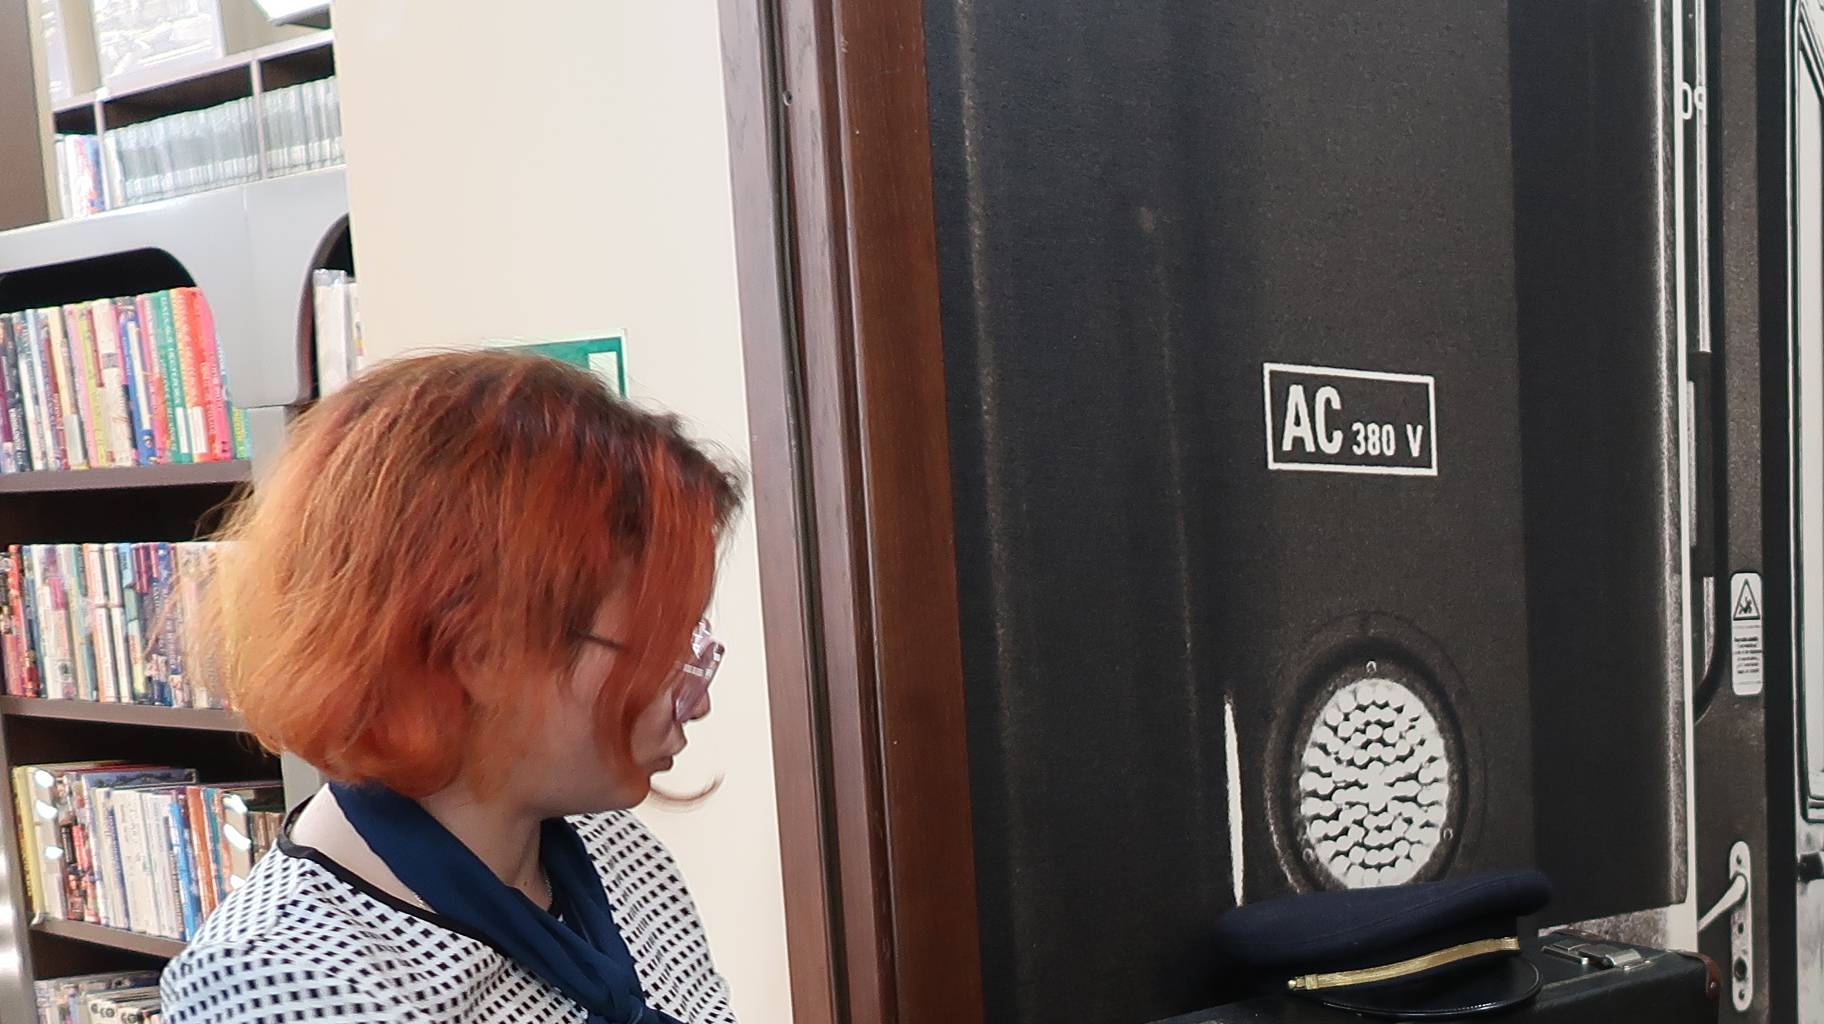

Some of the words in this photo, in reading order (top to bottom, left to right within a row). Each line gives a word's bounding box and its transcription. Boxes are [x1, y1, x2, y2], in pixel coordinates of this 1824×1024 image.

[1282, 384, 1344, 455] AC
[1352, 422, 1396, 456] 380
[1406, 423, 1424, 458] V
